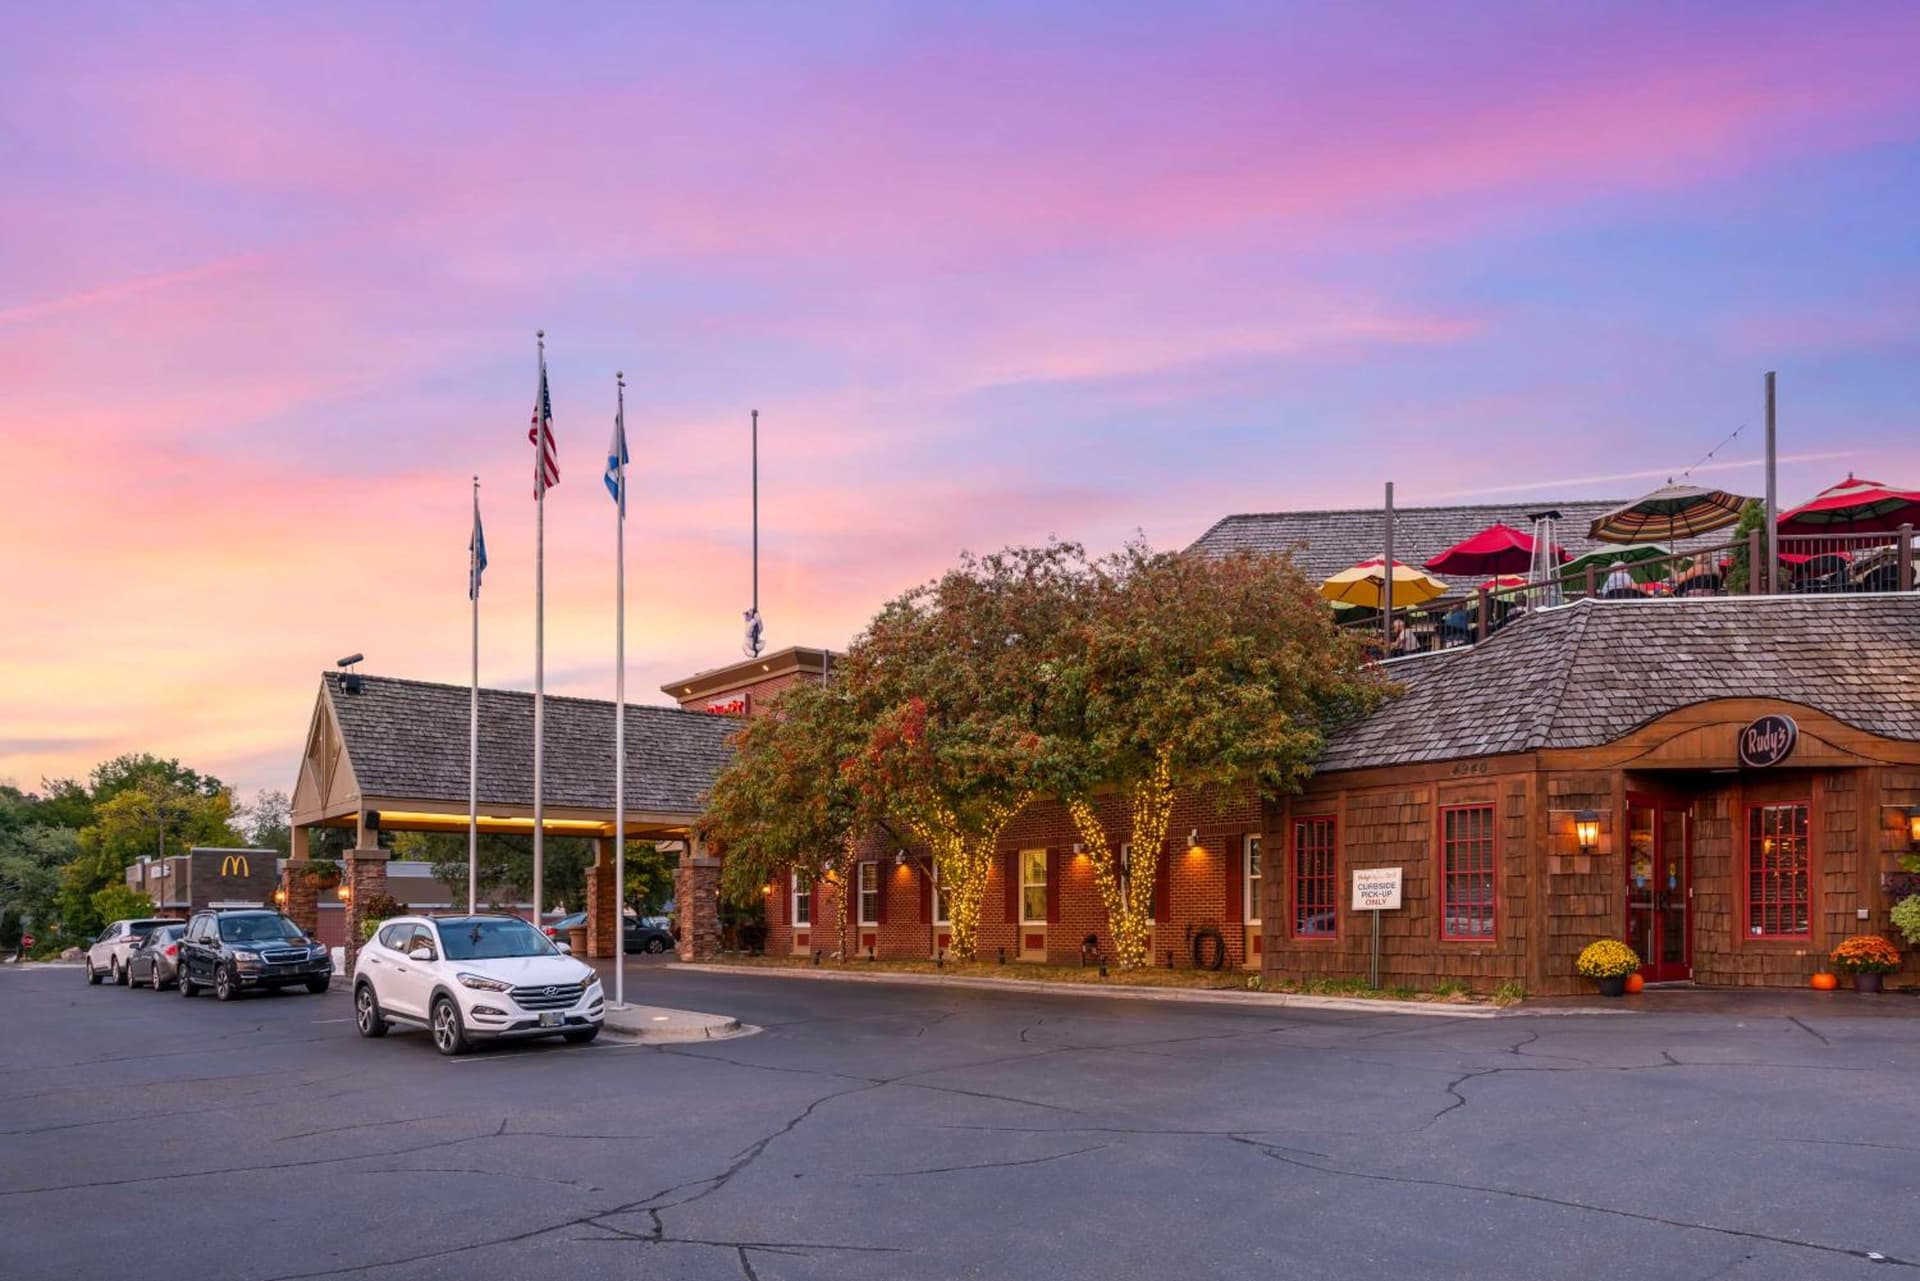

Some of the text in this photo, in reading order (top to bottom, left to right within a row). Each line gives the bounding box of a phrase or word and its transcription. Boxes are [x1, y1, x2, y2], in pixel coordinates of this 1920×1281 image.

[1748, 720, 1786, 760] Rudy's
[1357, 881, 1397, 890] CURBSIDE
[1361, 889, 1393, 898] PICK-UP
[1365, 898, 1387, 906] ONLY
